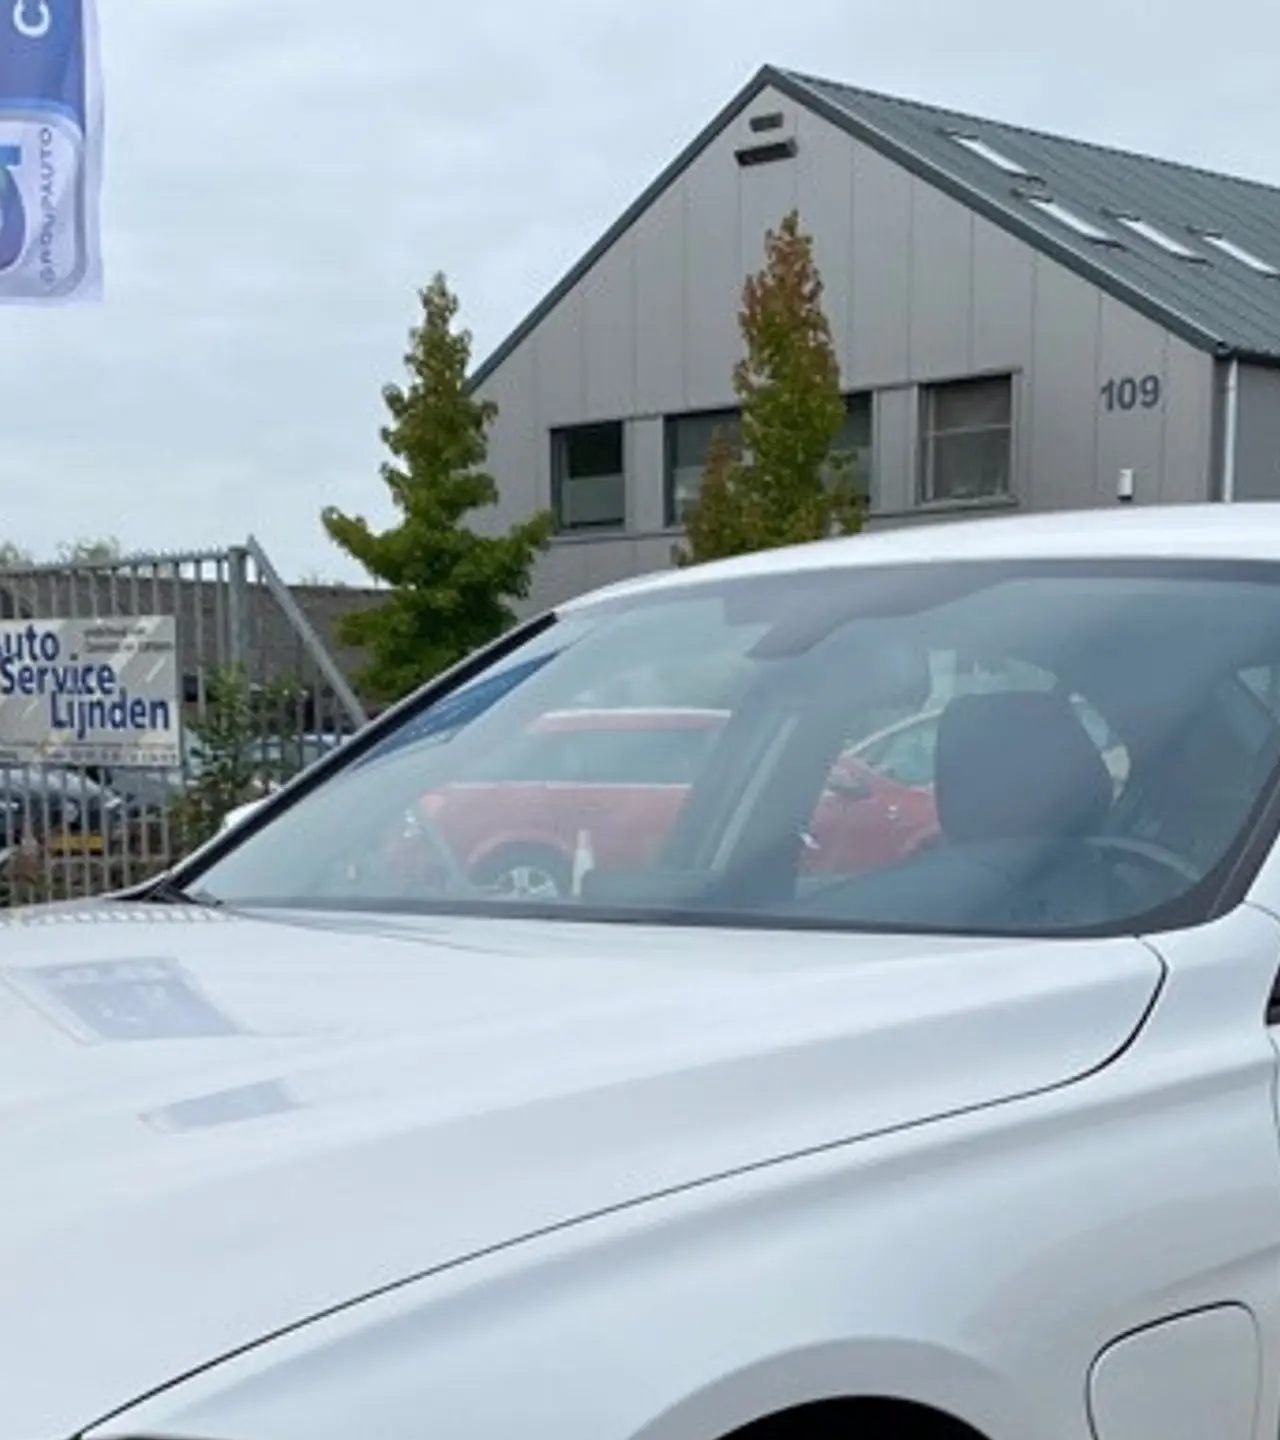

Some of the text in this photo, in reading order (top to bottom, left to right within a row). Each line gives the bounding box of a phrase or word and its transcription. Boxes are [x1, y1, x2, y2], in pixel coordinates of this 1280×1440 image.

[1100, 374, 1161, 412] 109
[0, 653, 117, 696] Service
[50, 687, 171, 741] Lijnden
